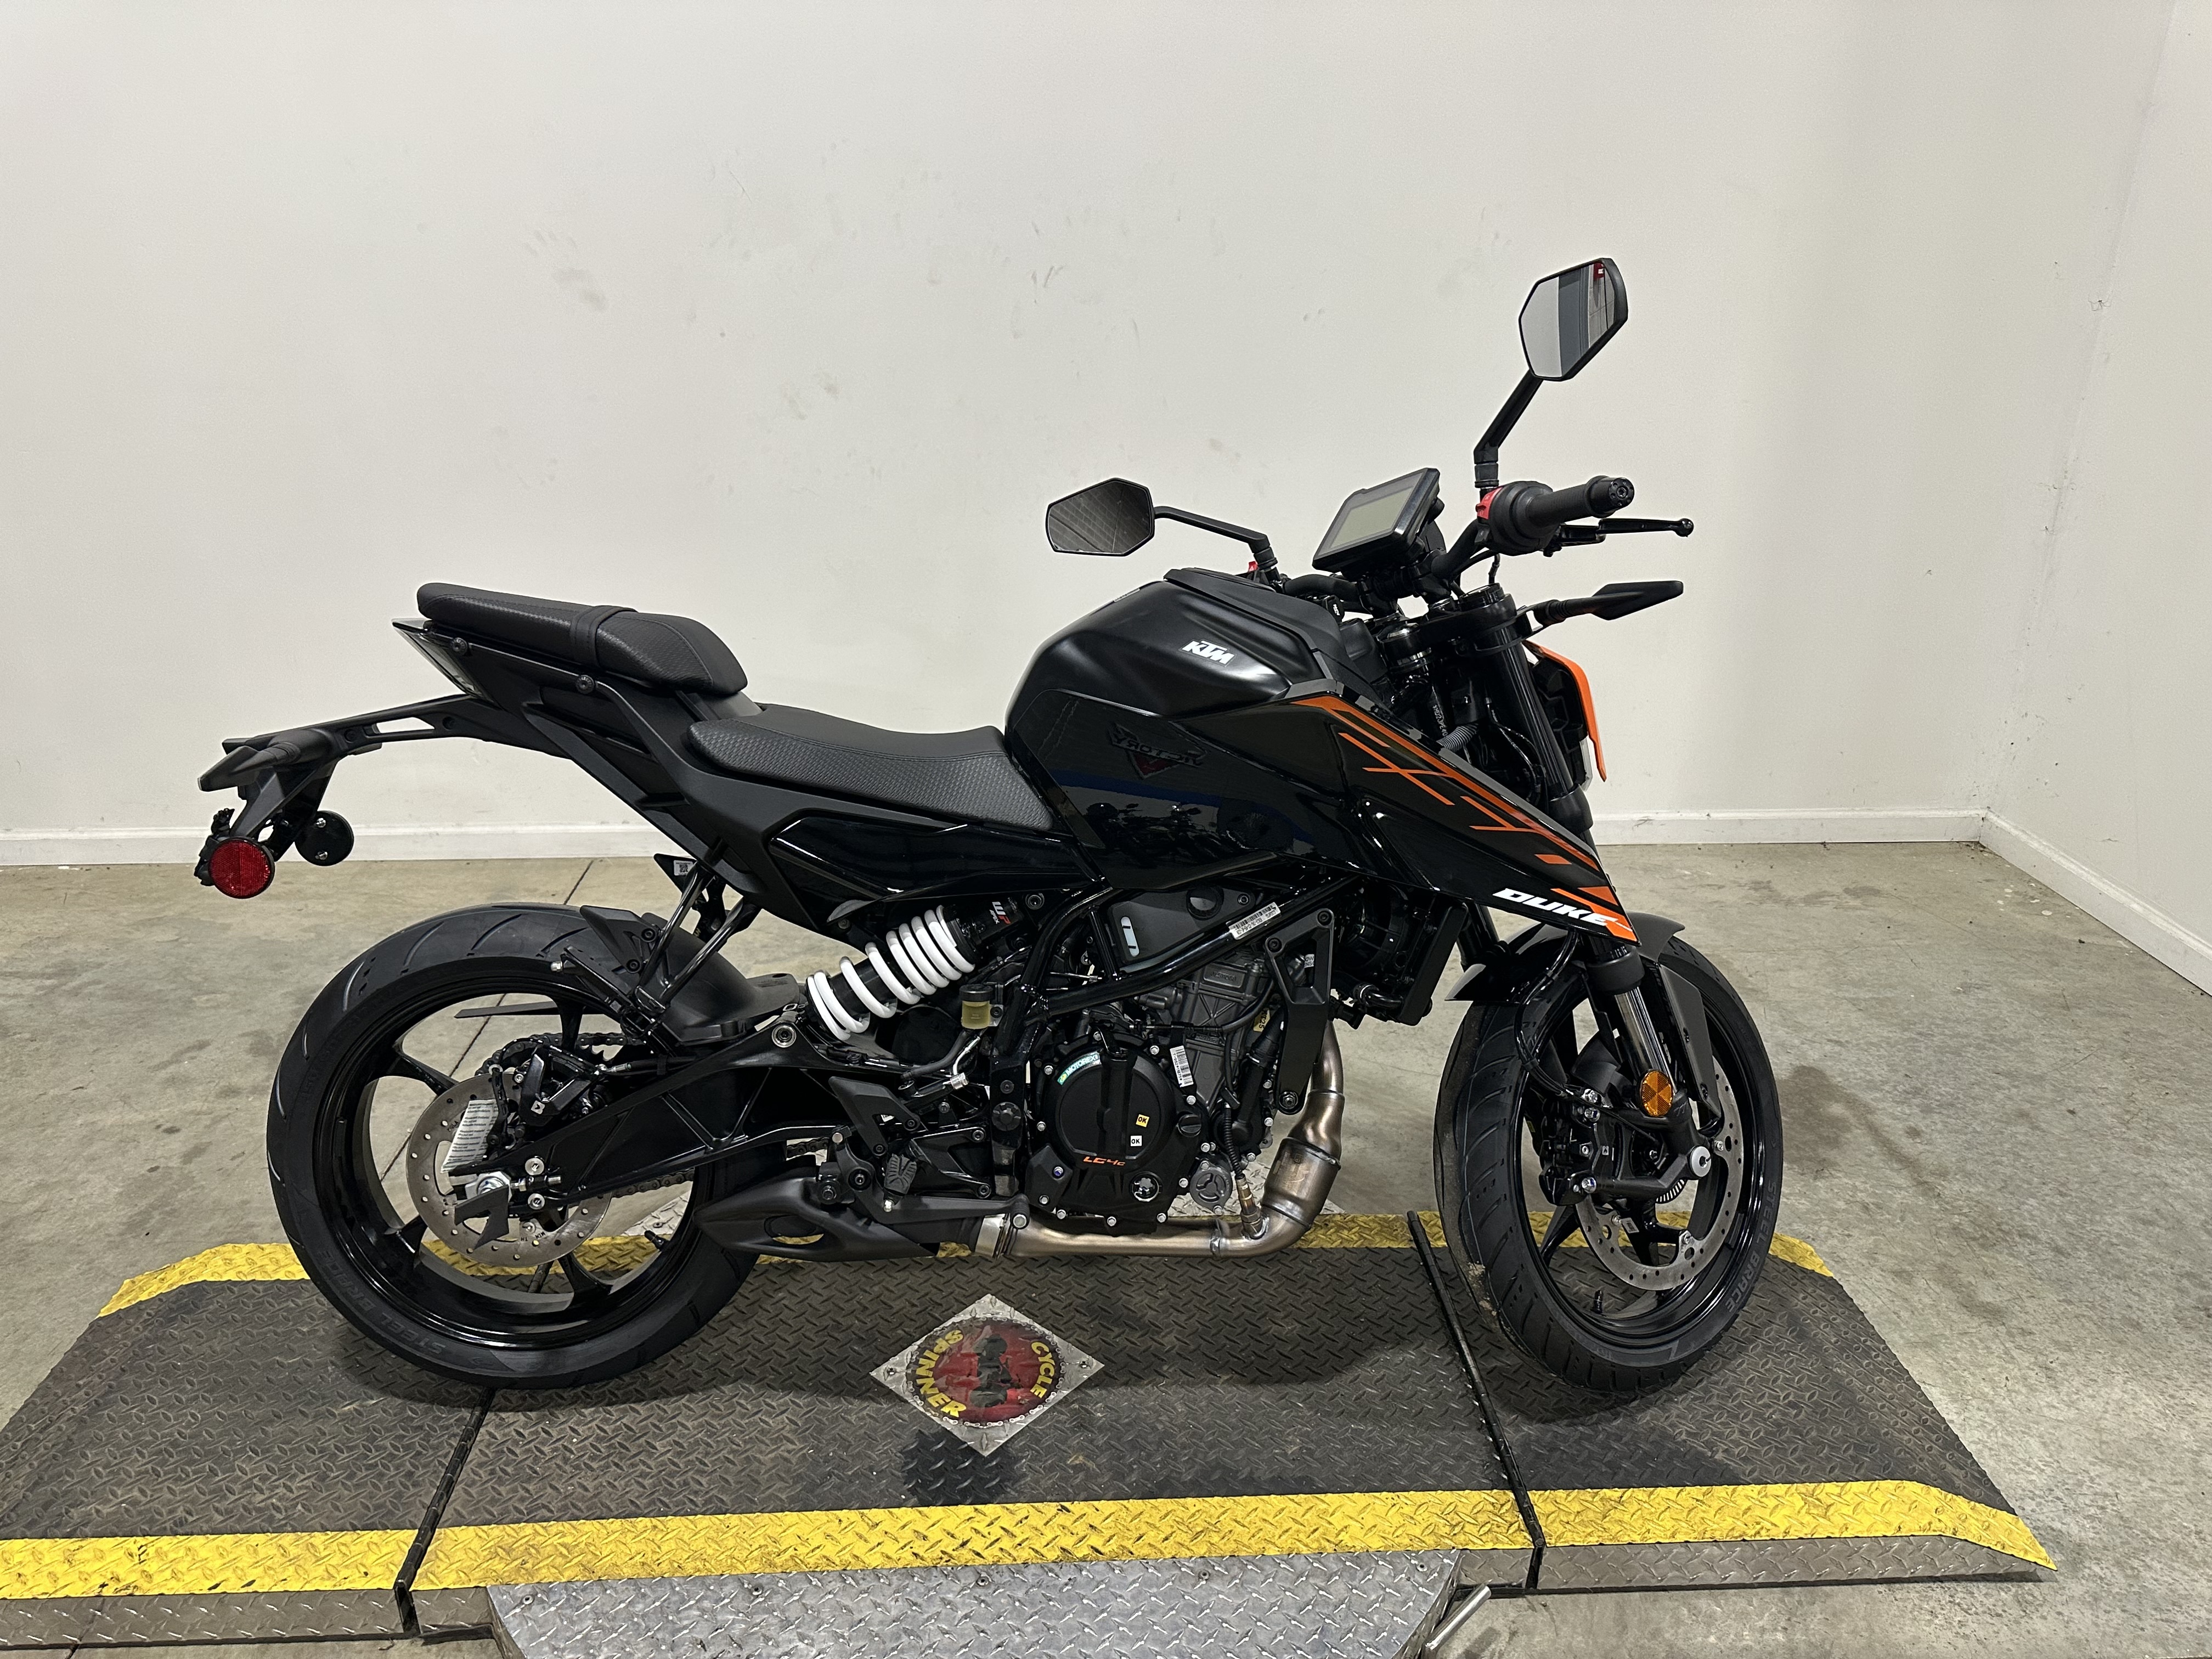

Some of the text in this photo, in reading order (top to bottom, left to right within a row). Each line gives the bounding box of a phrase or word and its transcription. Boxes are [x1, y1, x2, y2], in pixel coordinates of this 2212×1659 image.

[1181, 640, 1235, 664] KTM
[991, 901, 1011, 924] WP
[1492, 888, 1618, 926] DUKE
[1064, 1054, 1097, 1076] MOTOREX
[1725, 1181, 1777, 1312] STEEL BRACE
[380, 1312, 447, 1354] STEEL
[916, 1329, 967, 1418] SPINNER
[1031, 1341, 1056, 1398] CYCLE
